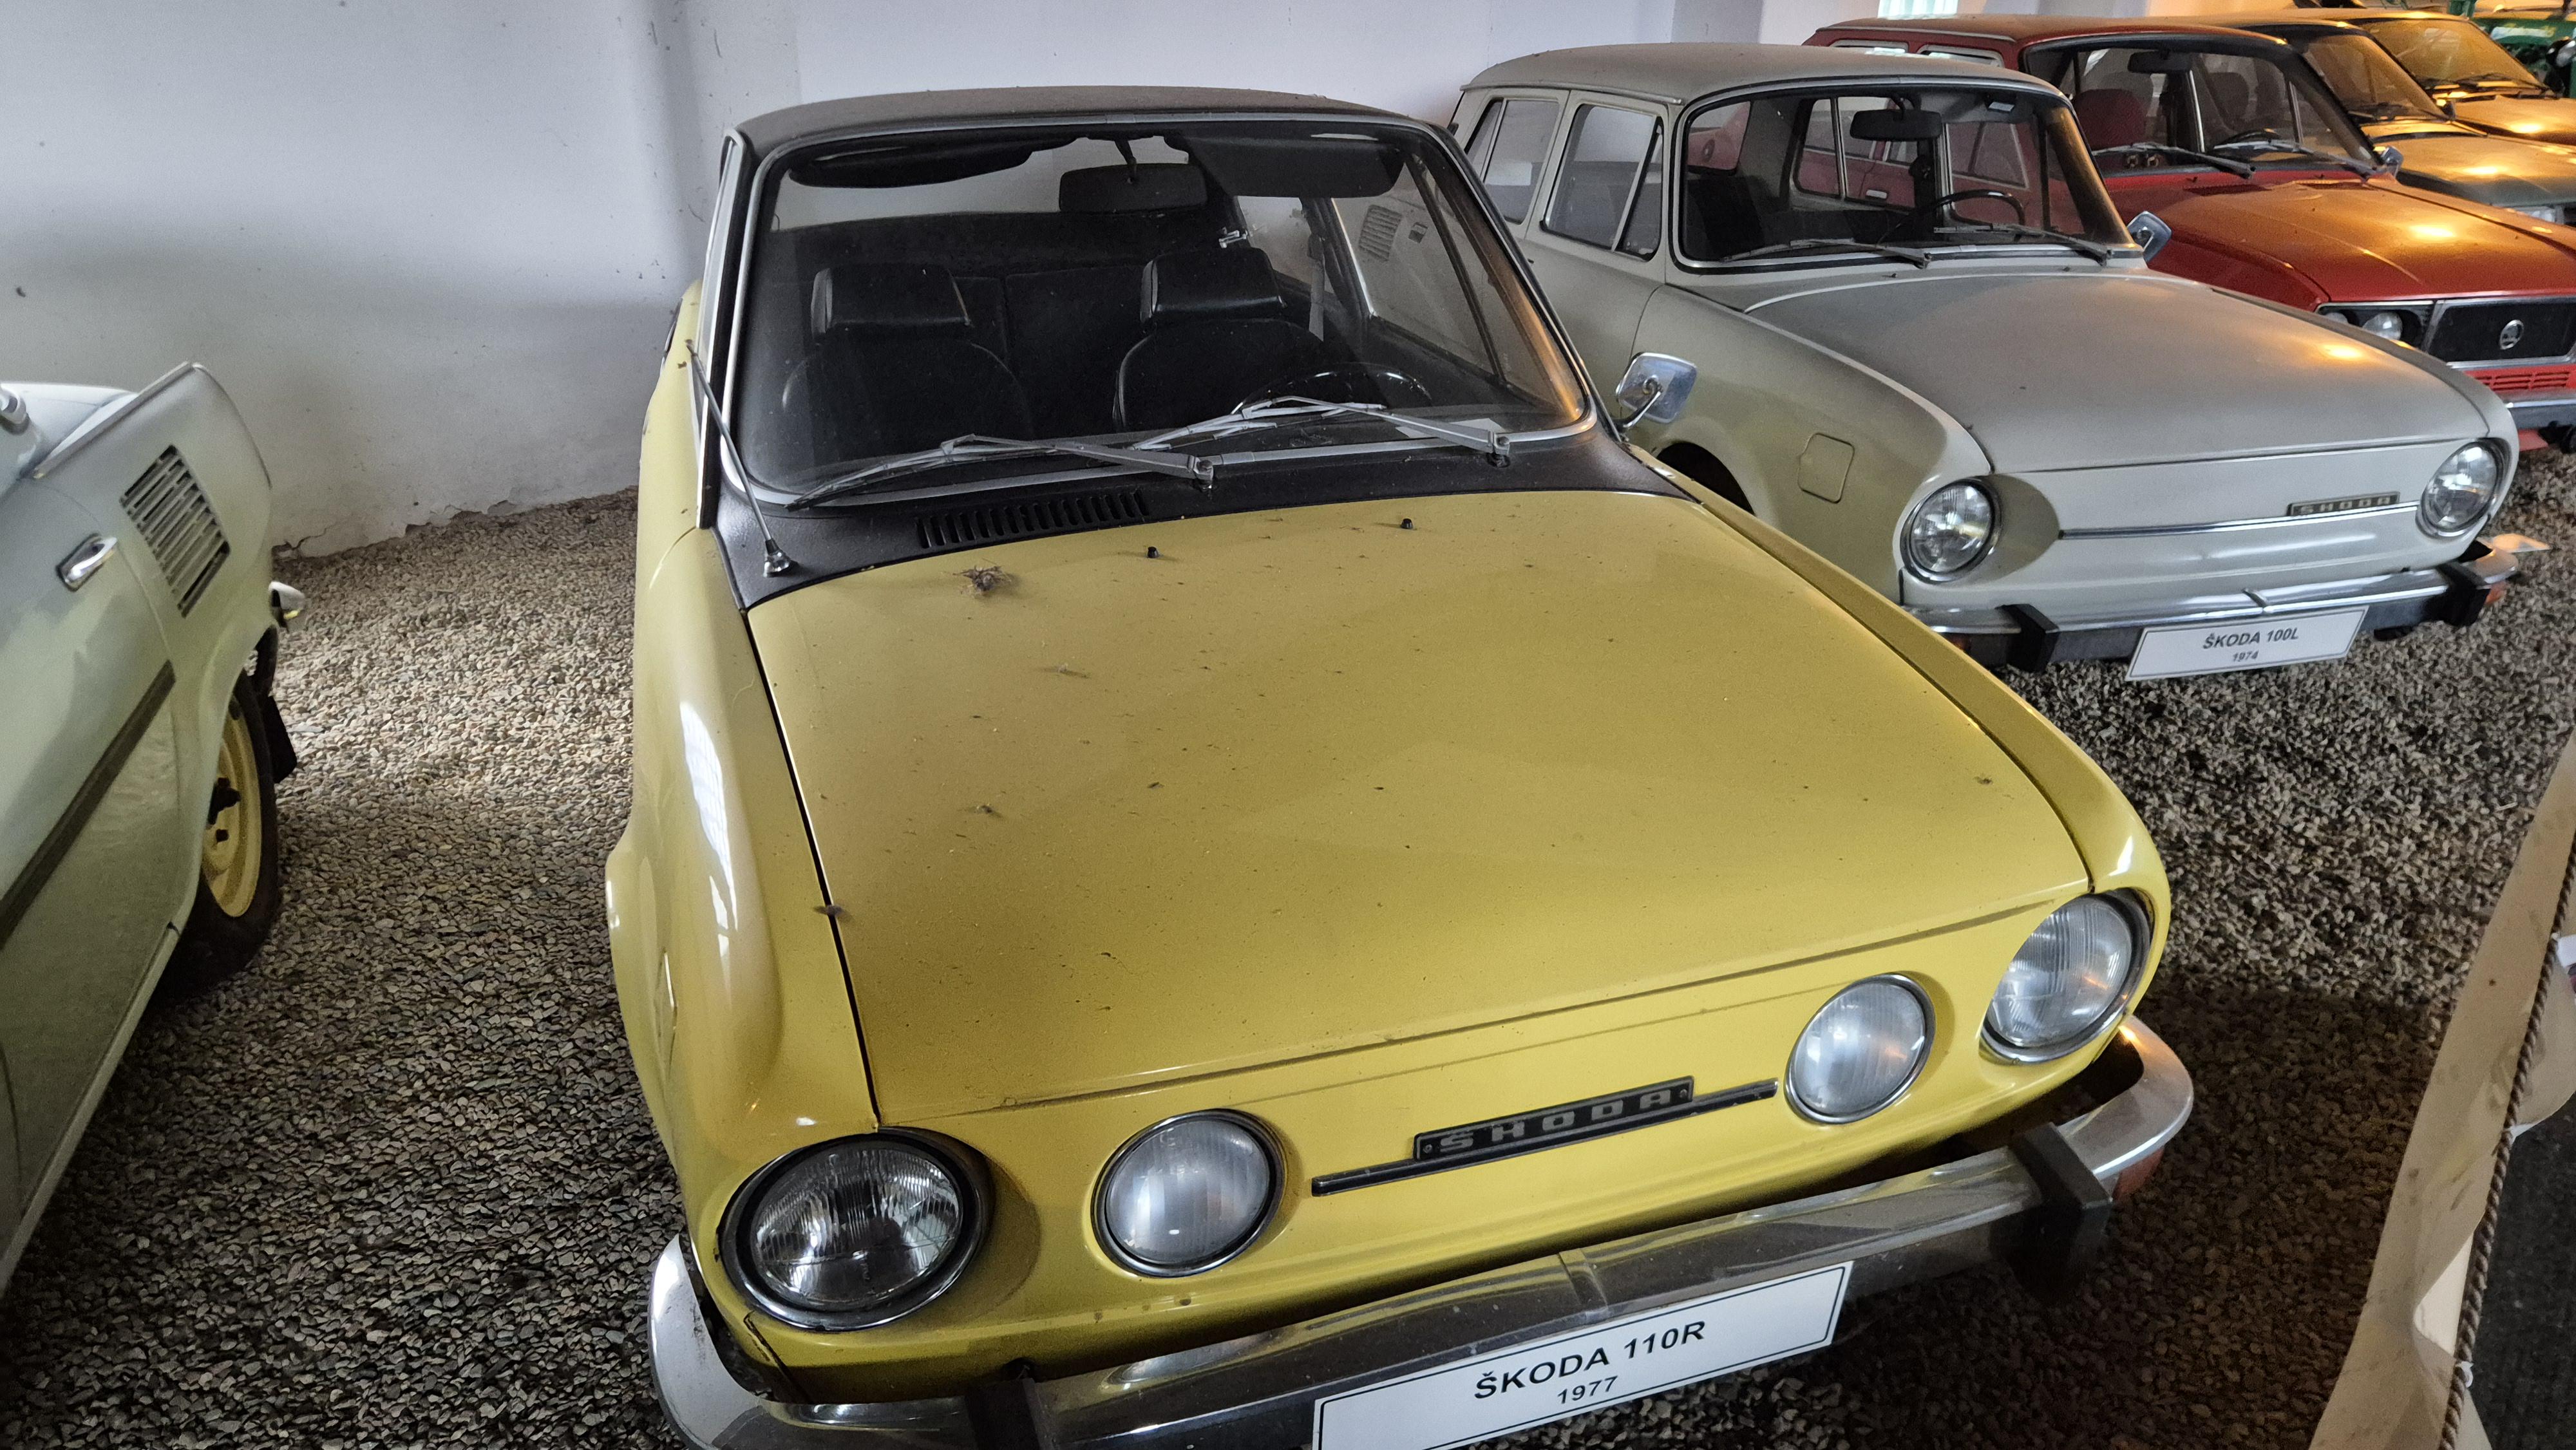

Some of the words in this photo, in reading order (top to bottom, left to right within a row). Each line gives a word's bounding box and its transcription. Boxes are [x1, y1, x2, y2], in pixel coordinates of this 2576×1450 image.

[2202, 632, 2260, 649] ŠKODA
[2267, 627, 2298, 642] 100L
[2232, 650, 2259, 662] 1974
[1473, 1347, 1609, 1399] ŠKODA
[1624, 1321, 1705, 1359] 110R
[1557, 1375, 1618, 1404] 1977
